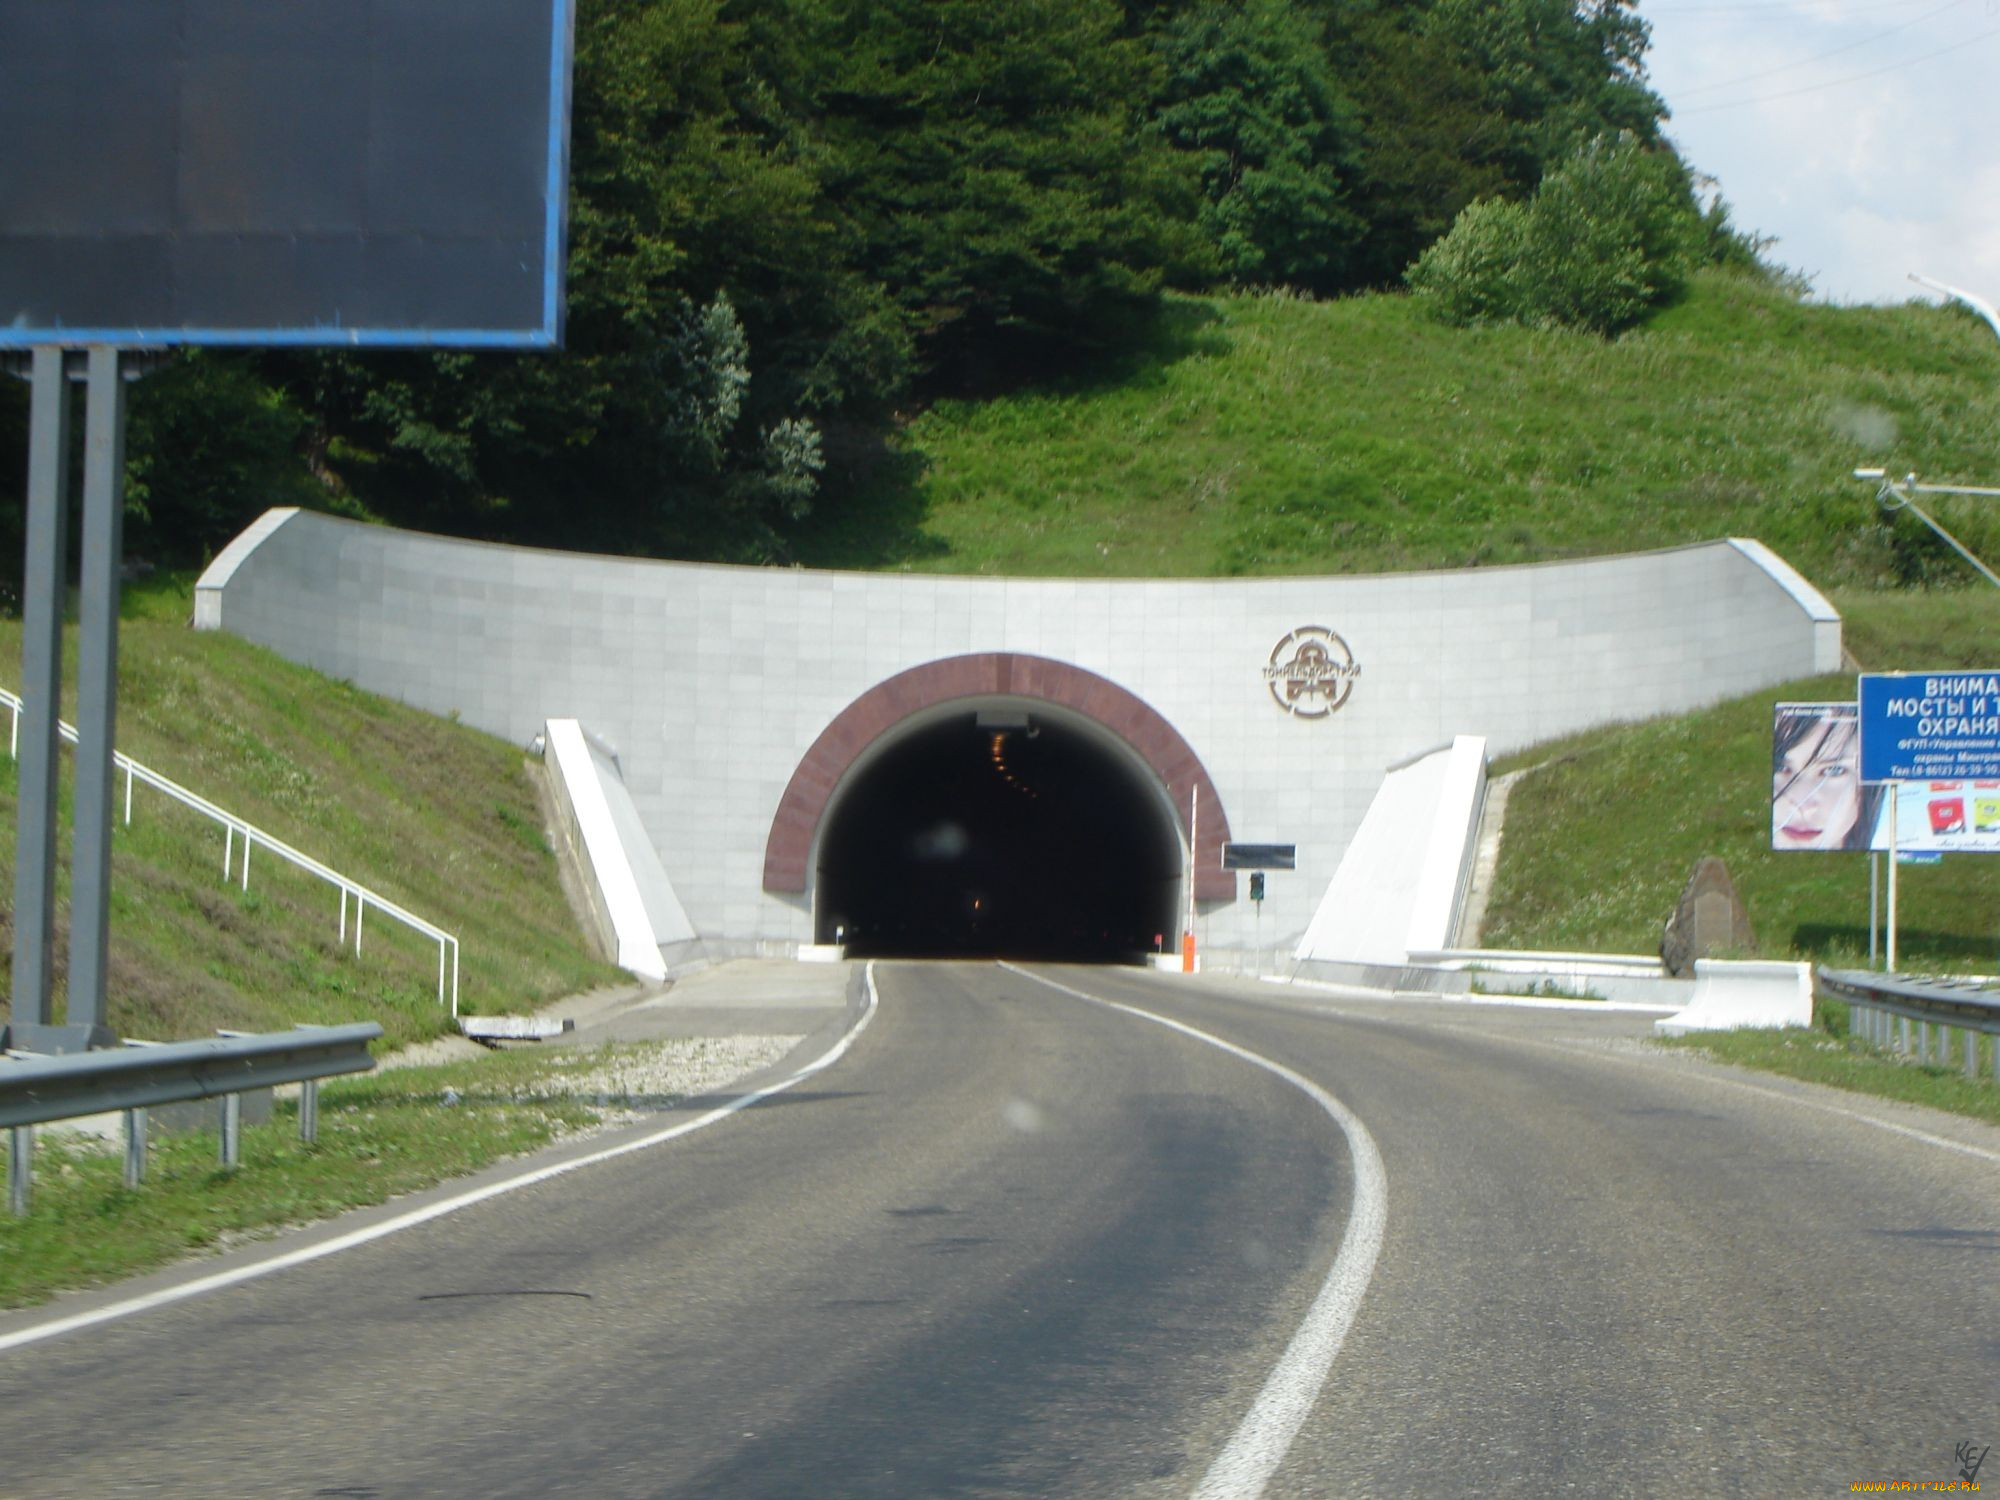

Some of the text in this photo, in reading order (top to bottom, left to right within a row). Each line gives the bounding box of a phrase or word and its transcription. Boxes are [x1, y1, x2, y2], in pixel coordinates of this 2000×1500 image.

[1925, 677, 1999, 697] ВНИМА
[1887, 697, 1965, 718] МОСТЫ
[1971, 697, 1986, 716] И
[1917, 716, 1999, 736] ОХРАНЯ
